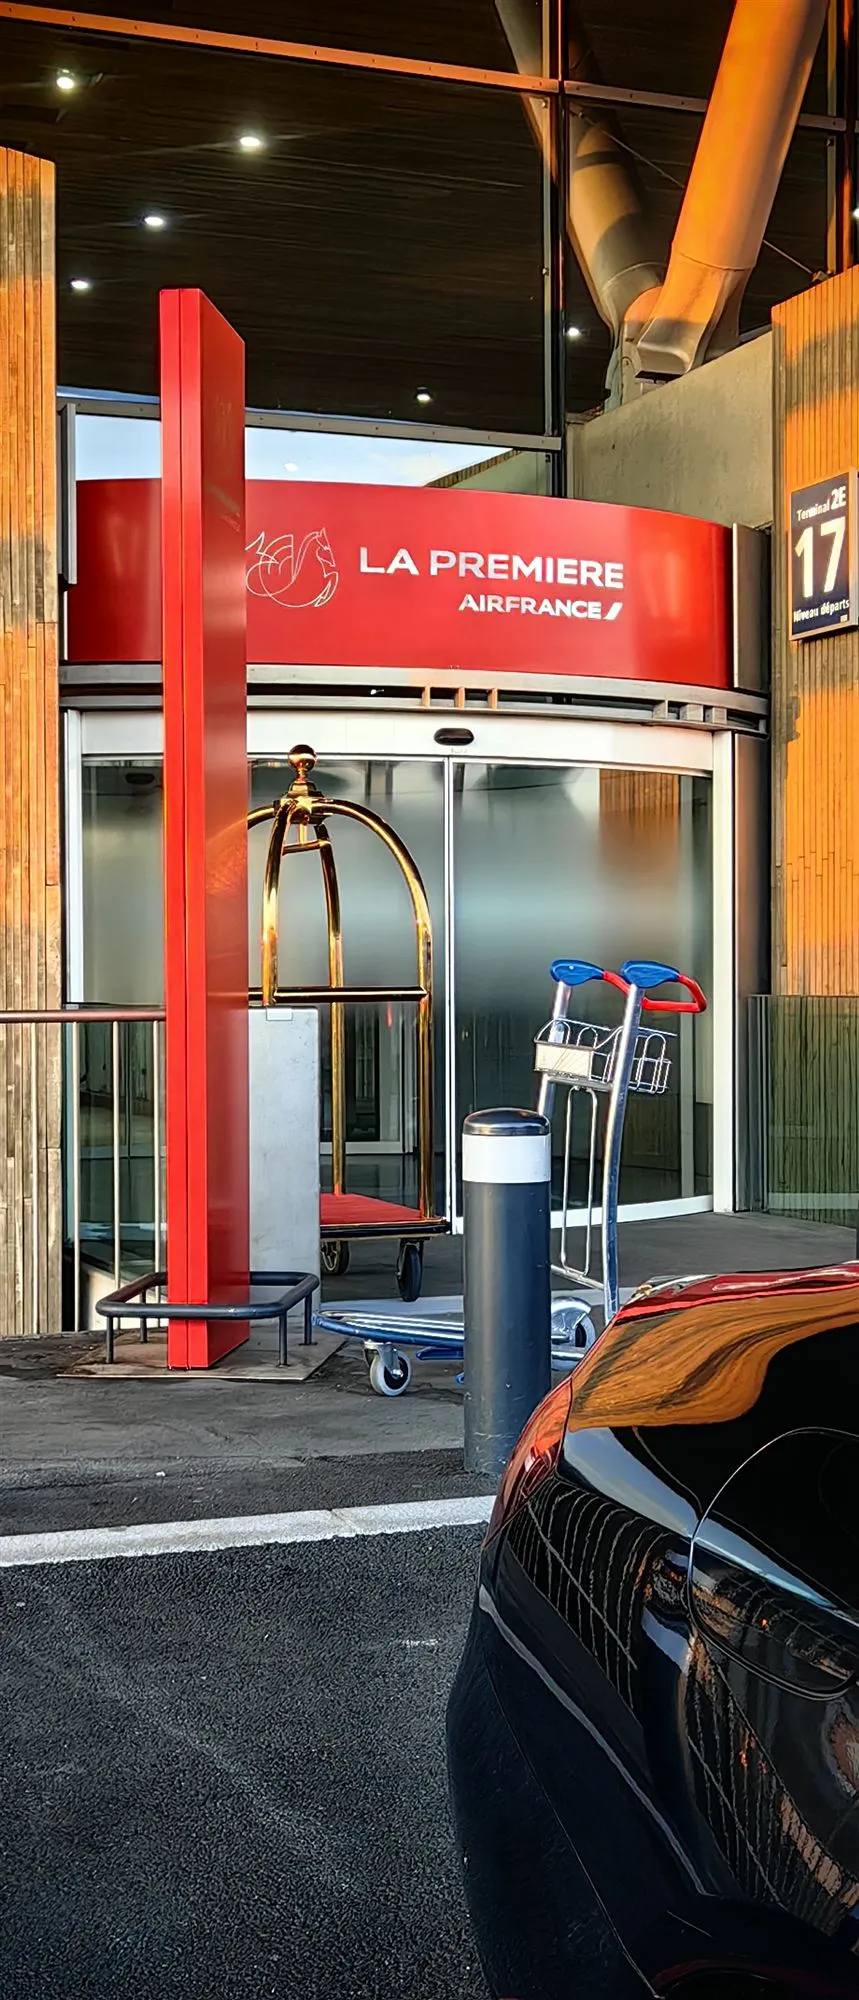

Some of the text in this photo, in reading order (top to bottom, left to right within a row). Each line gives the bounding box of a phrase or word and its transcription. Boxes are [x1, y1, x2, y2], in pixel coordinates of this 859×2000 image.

[796, 485, 847, 521] Terminal 2E
[359, 546, 624, 589] LA PREMIERE
[795, 516, 846, 598] 17
[458, 593, 602, 619] AIRFRANCE
[793, 599, 850, 623] Niveau départs
